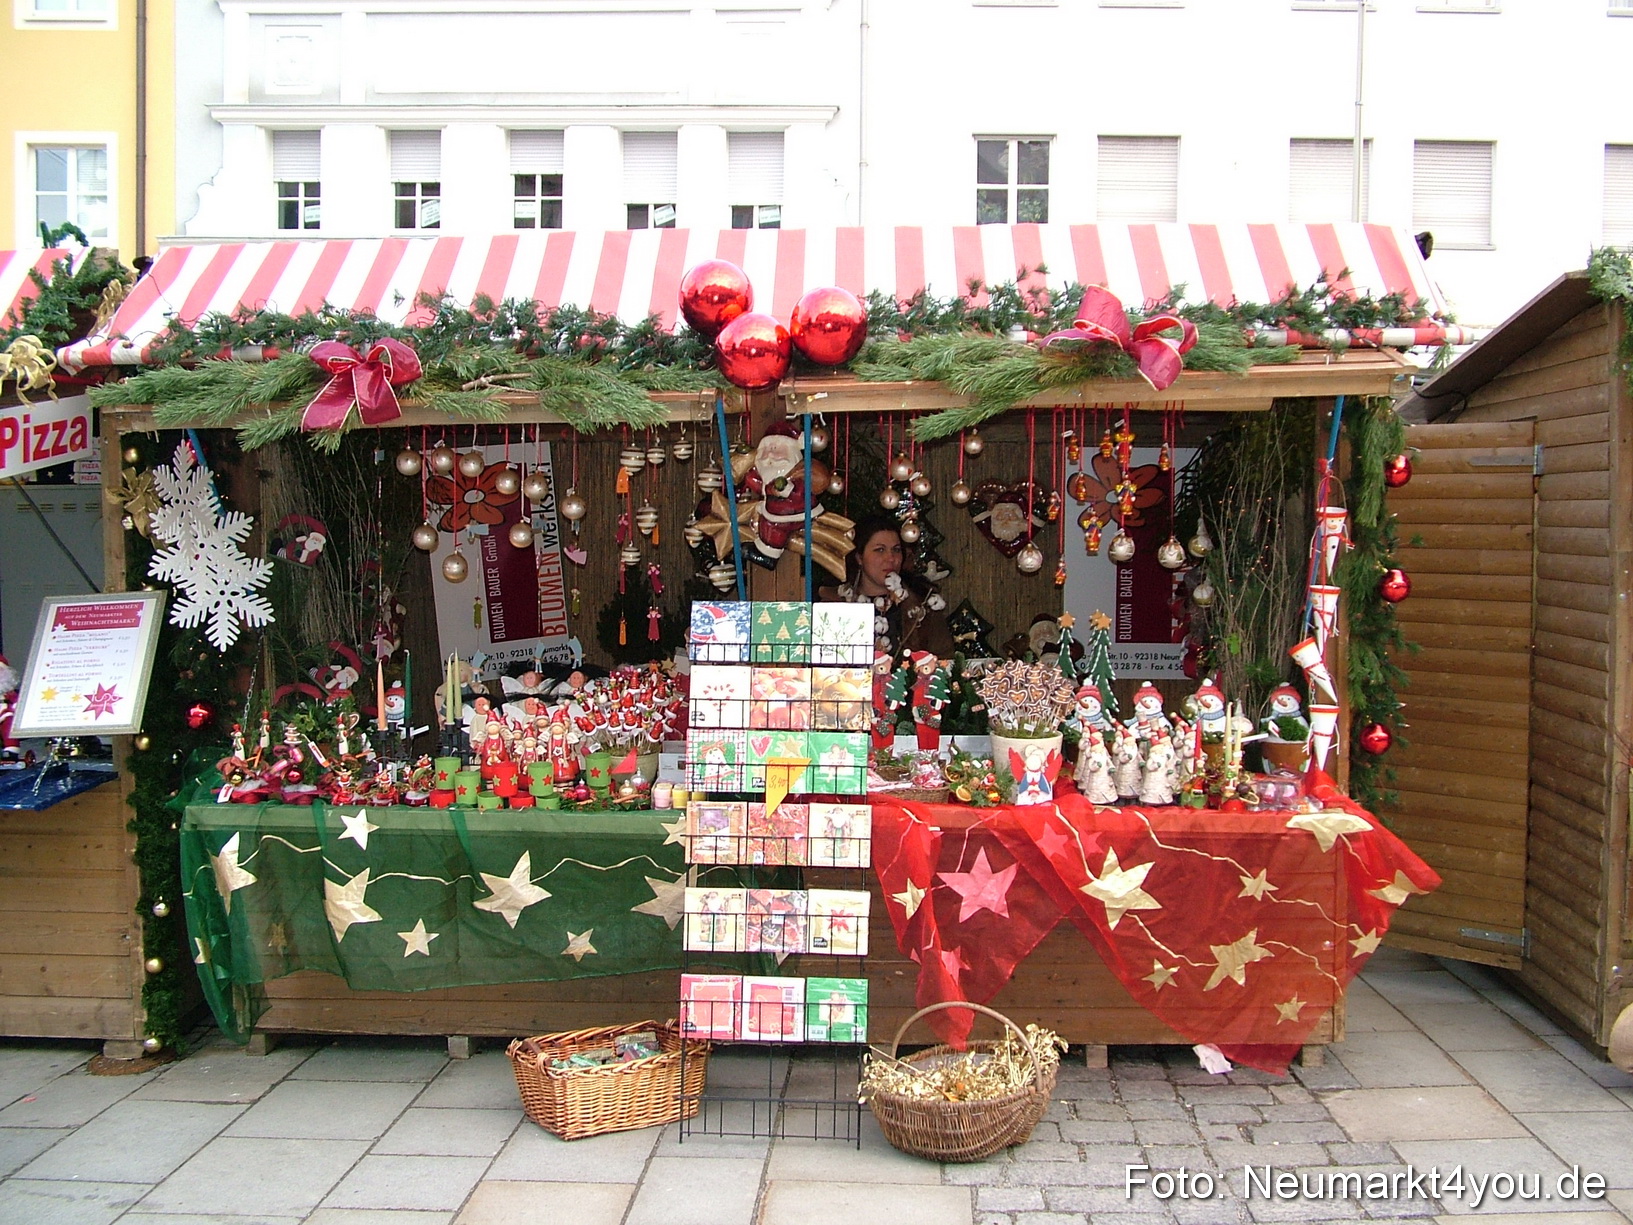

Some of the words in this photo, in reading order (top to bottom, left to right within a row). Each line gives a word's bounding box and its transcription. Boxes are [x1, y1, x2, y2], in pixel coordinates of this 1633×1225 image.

[0, 414, 88, 469] Pizza
[487, 567, 502, 597] BAUER
[541, 552, 567, 638] BLUMEN
[1120, 568, 1133, 597] BAUER
[490, 602, 506, 640] BLUMEN
[1119, 603, 1132, 640] BLUMEN
[510, 648, 533, 658] 92318
[1120, 652, 1129, 660] 10
[1135, 652, 1159, 661] 92318
[1150, 662, 1165, 670] Fax
